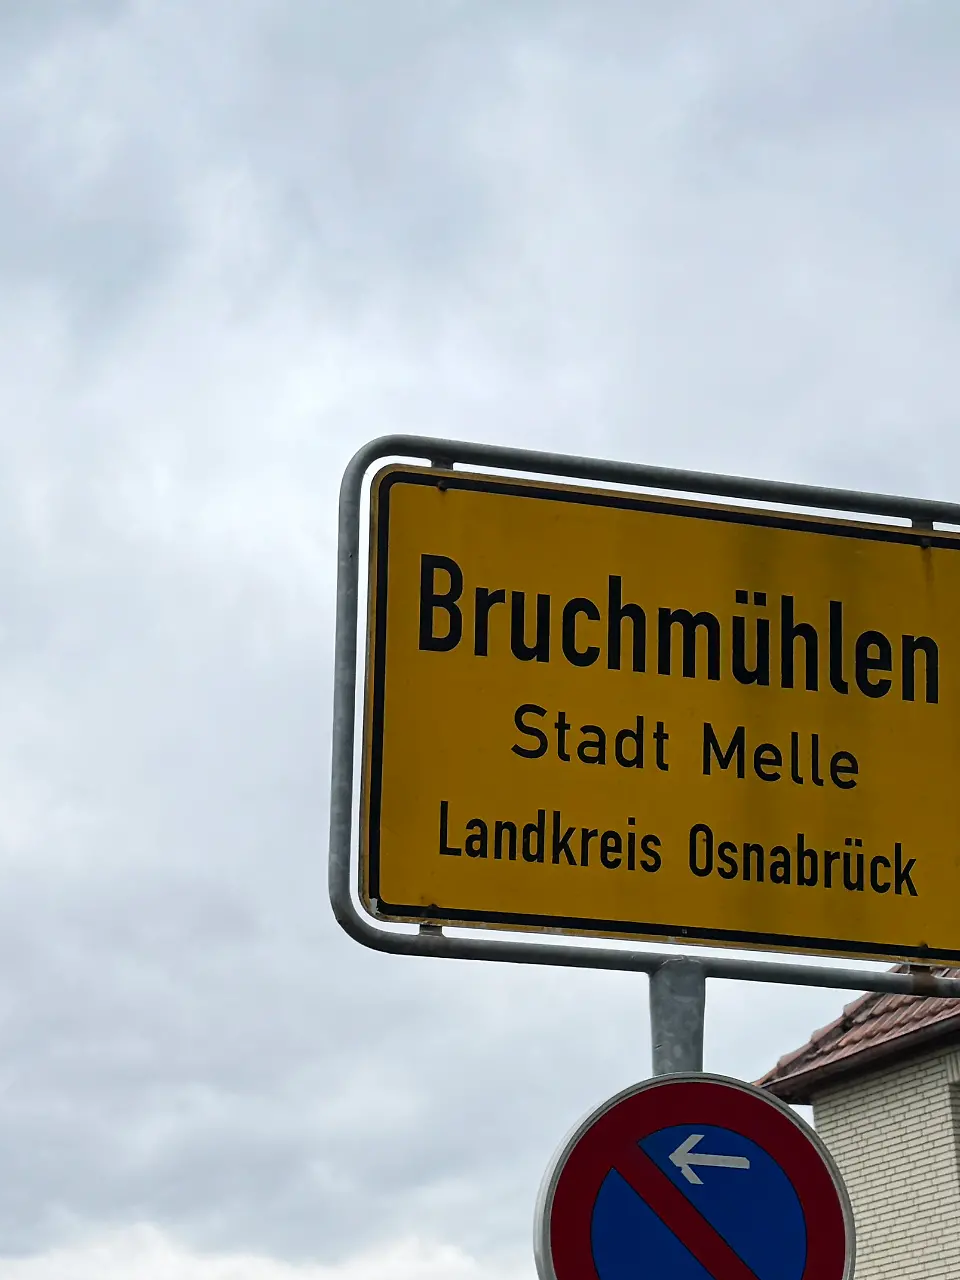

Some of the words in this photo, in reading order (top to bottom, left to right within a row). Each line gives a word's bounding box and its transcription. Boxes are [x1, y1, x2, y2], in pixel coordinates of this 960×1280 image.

[418, 553, 940, 705] Bruchmühlen
[510, 703, 670, 772] Stadt
[702, 722, 860, 790] Melle
[439, 800, 663, 873] Landkreis
[688, 823, 919, 897] Osnabrück
